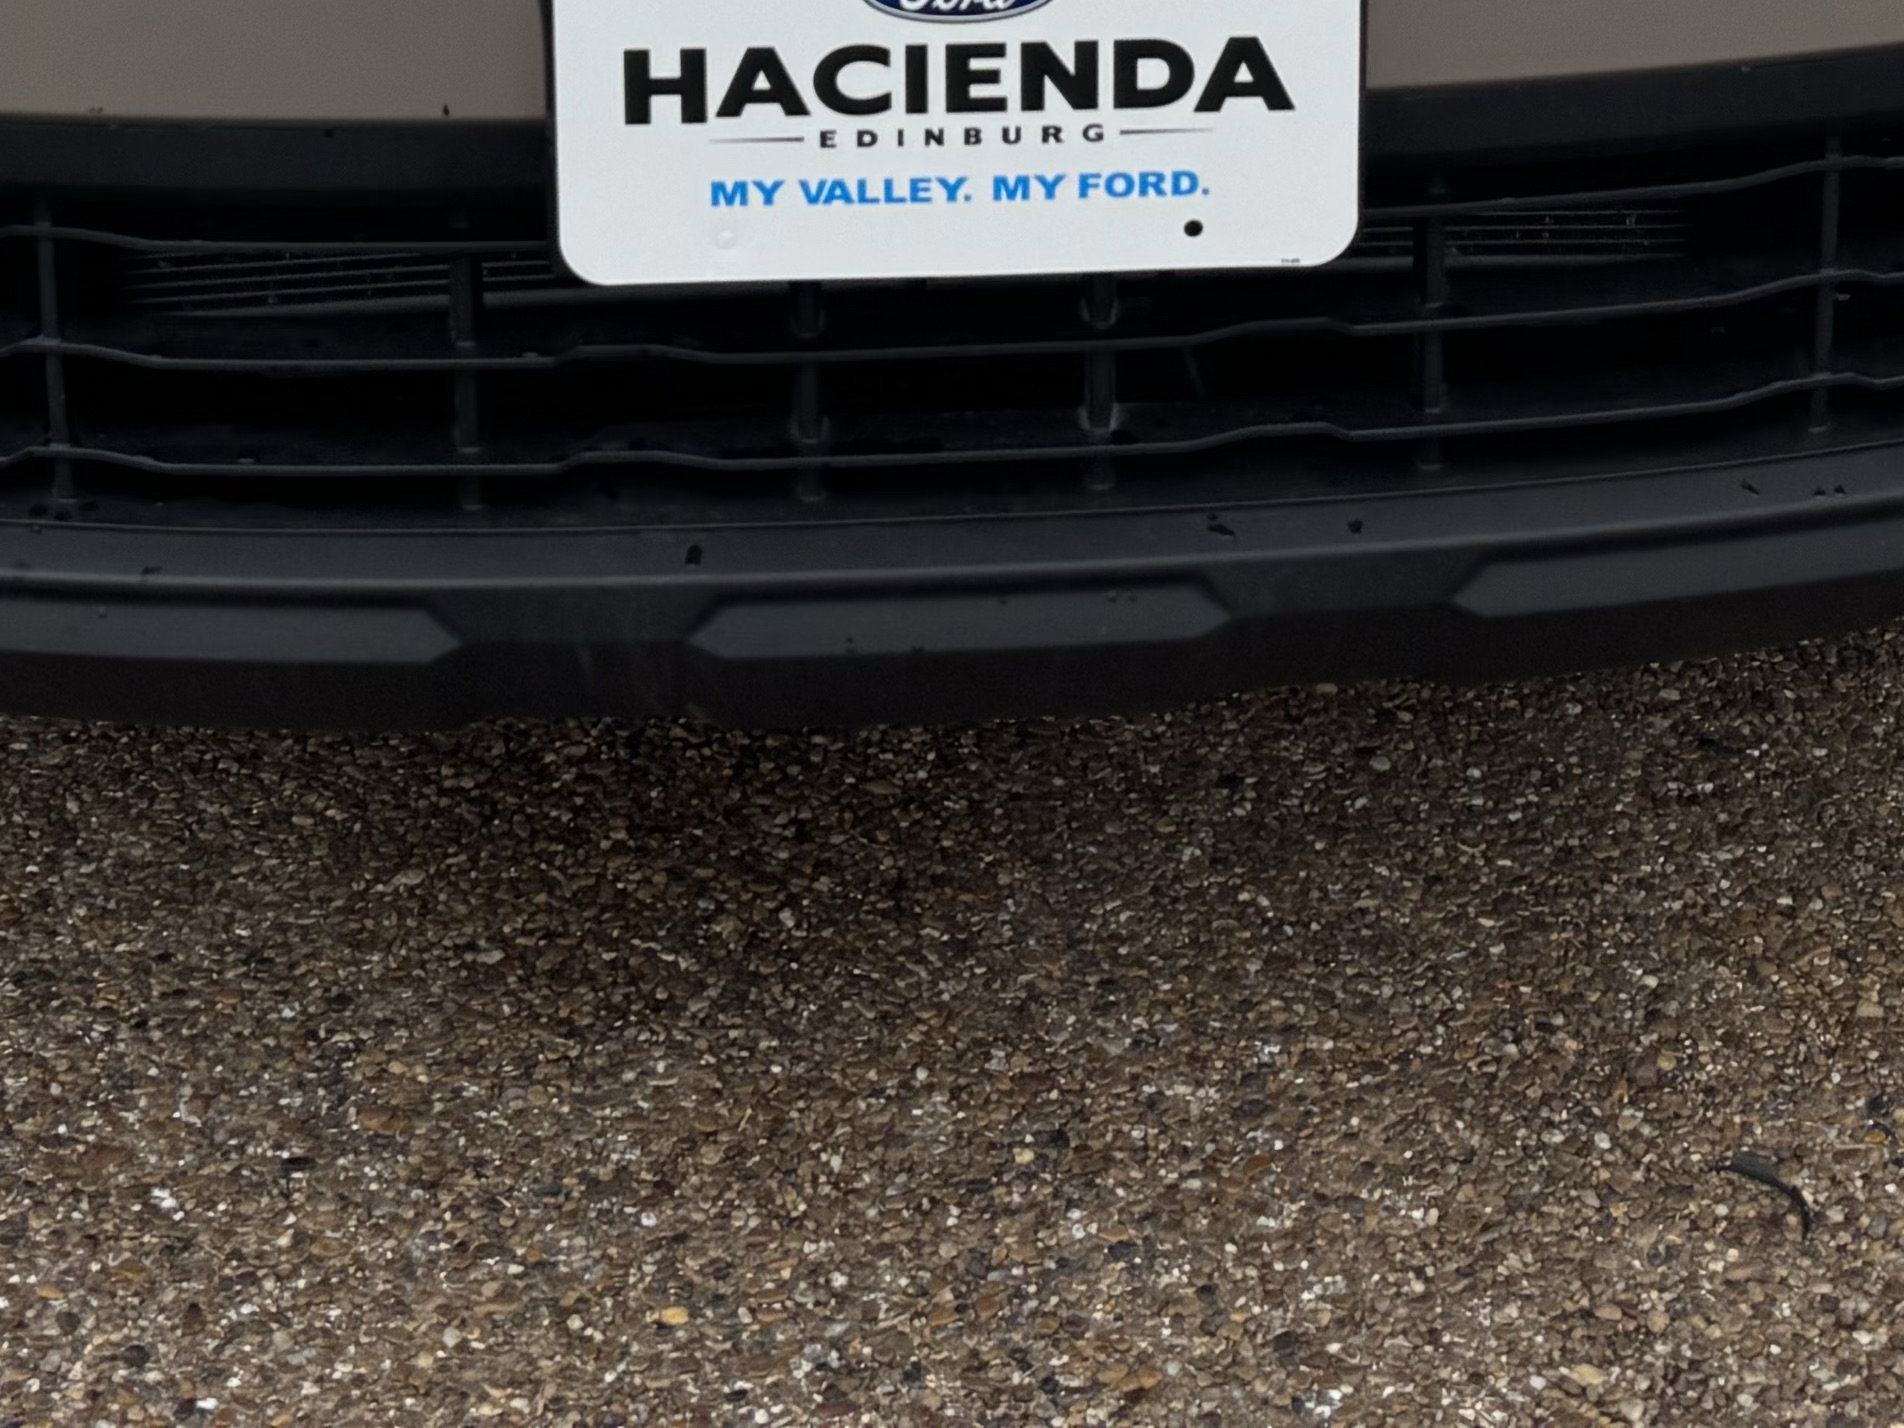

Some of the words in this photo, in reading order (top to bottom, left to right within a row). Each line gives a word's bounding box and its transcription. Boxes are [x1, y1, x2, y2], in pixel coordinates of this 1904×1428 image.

[622, 36, 1296, 126] HACIENDA
[819, 123, 1105, 149] EDINBURG
[709, 179, 785, 208] MY
[797, 176, 972, 205] VALLEY.
[992, 173, 1066, 201] MY
[1077, 170, 1210, 199] FORD.
